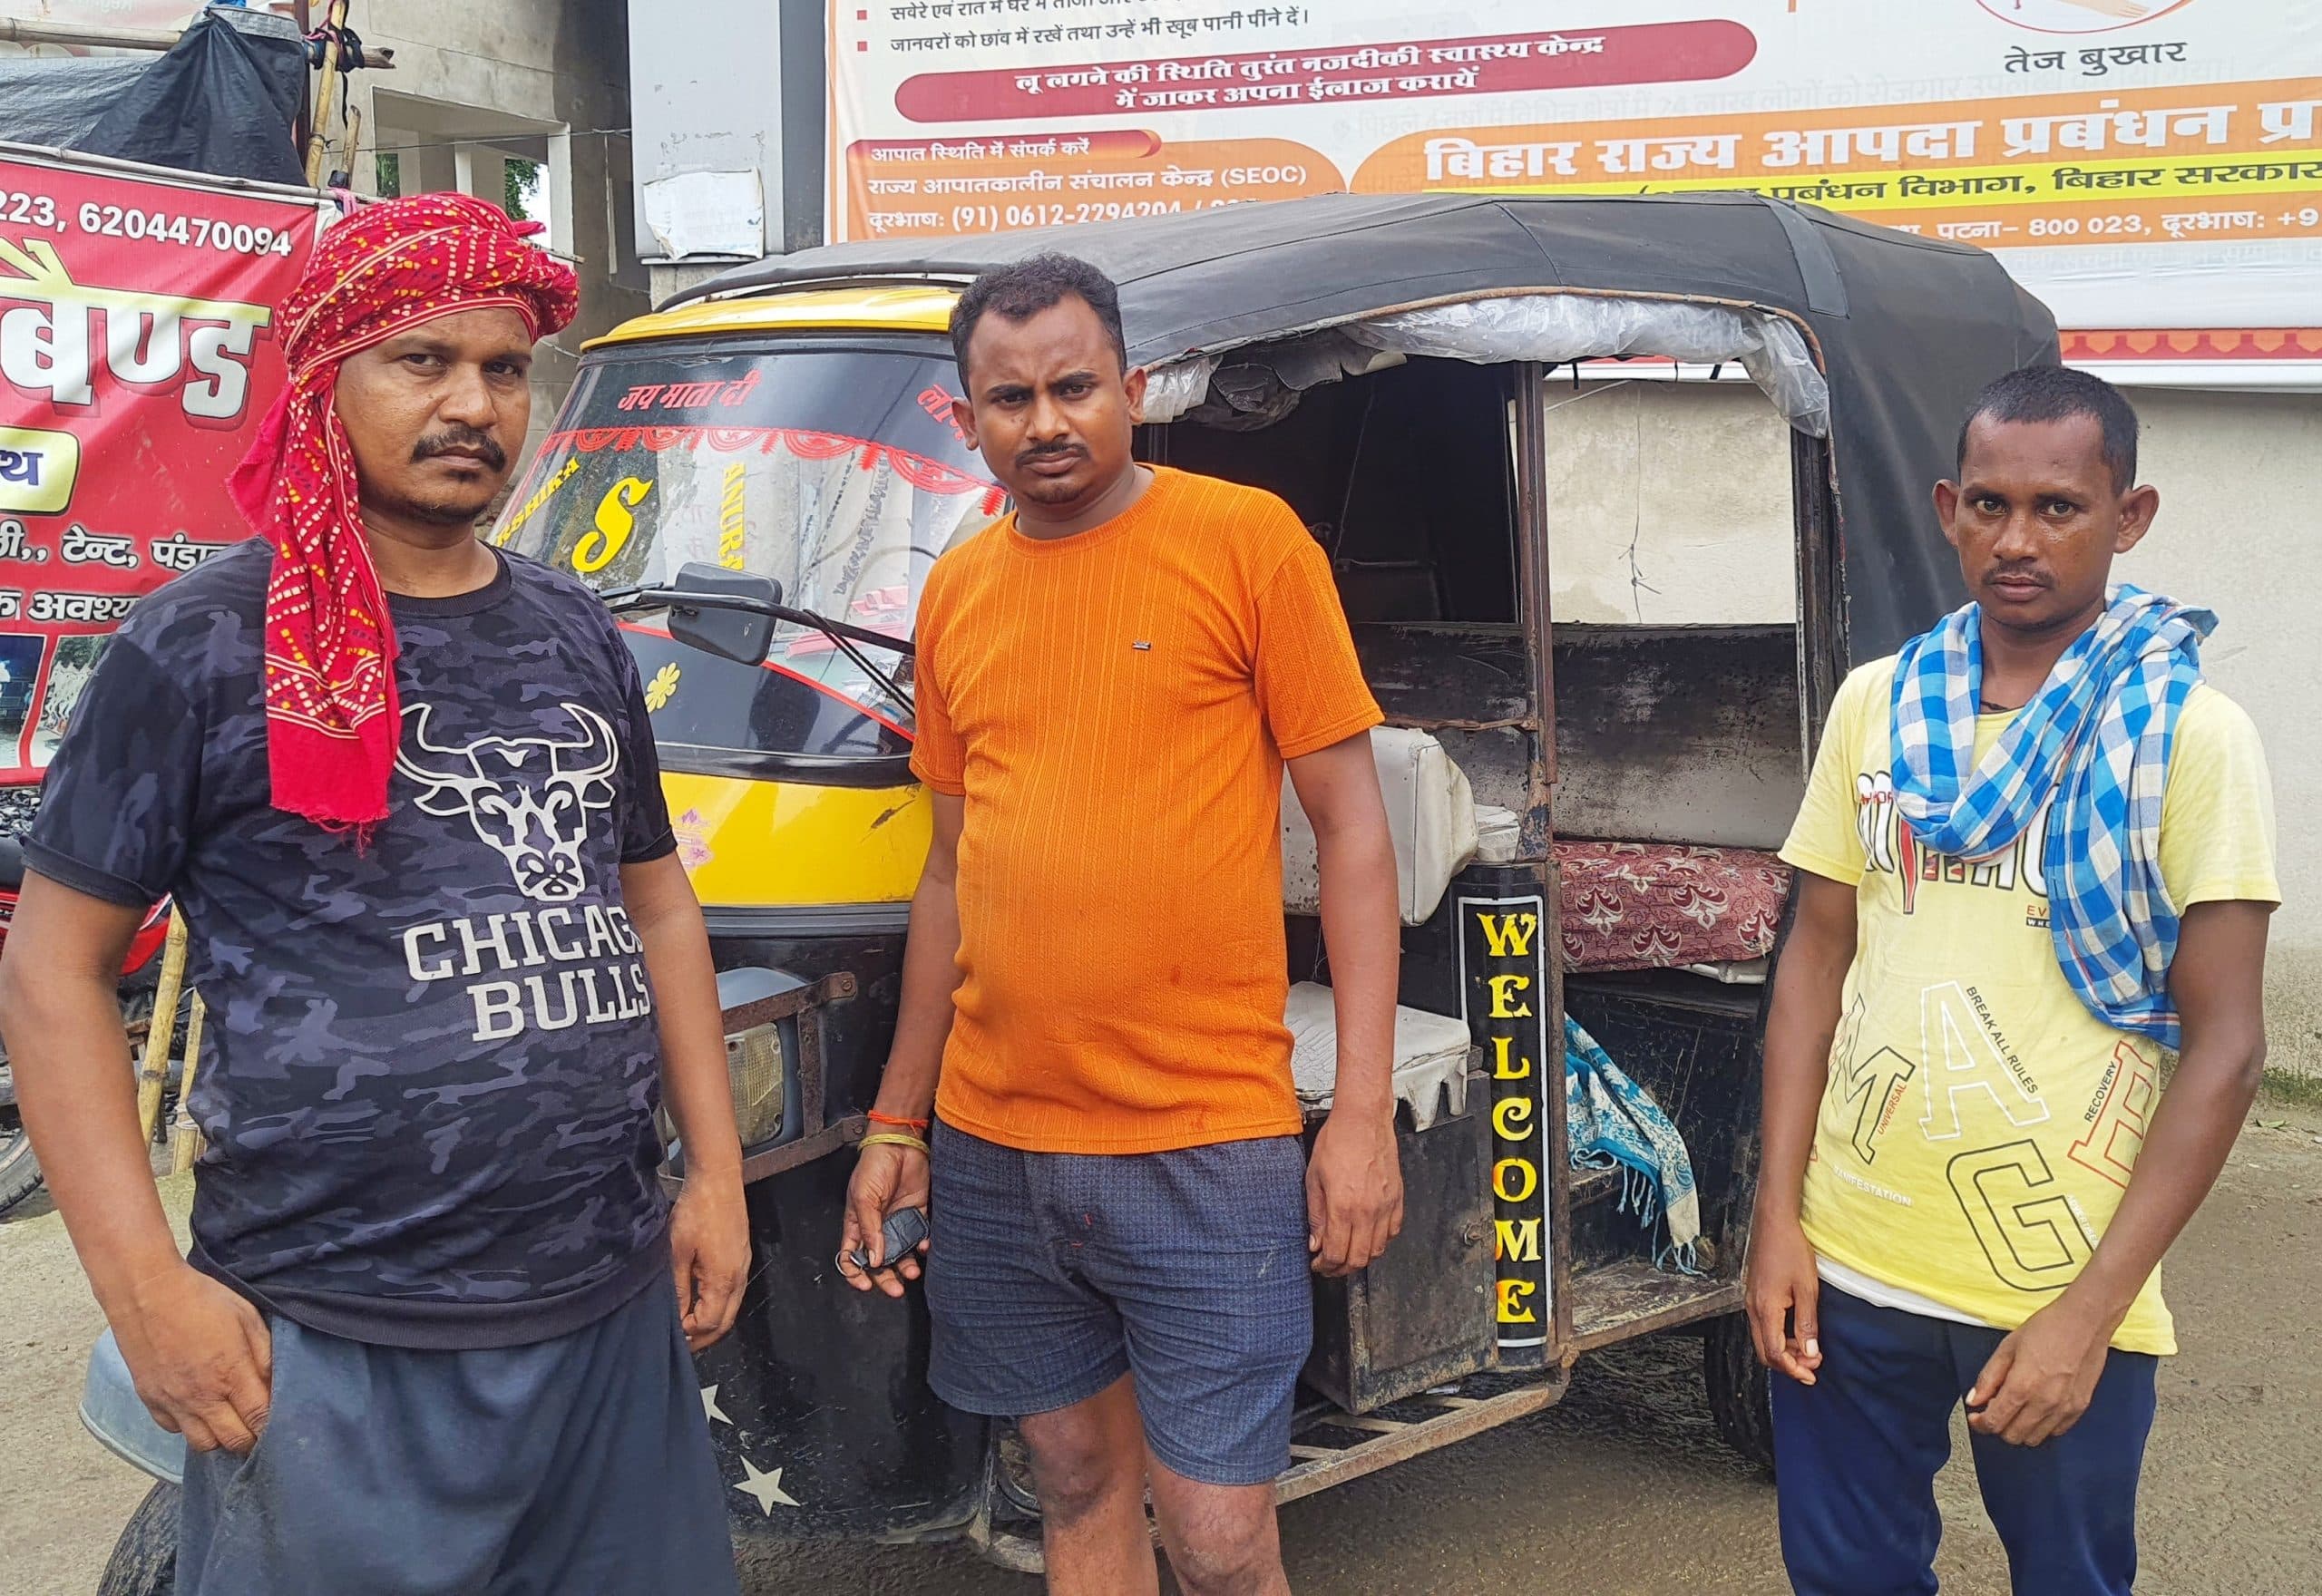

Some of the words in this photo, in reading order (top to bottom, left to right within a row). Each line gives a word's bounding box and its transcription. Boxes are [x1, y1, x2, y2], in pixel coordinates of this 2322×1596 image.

[890, 1, 928, 20] सवेरे
[932, 0, 954, 18] एवं
[957, 2, 987, 15] रात
[891, 33, 951, 52] जानवरों
[954, 30, 977, 48] को
[981, 29, 1010, 46] छांव
[1015, 26, 1032, 44] में
[1033, 24, 1064, 43] रखें
[1067, 25, 1101, 41] तथा
[1105, 18, 1137, 38] उन्हें
[1140, 16, 1162, 35] भी
[1166, 18, 1198, 39] खूब
[1203, 11, 1243, 32] पानी
[1246, 7, 1282, 28] पीने
[1014, 73, 1043, 94] लू
[1045, 66, 1109, 89] लगने
[1114, 63, 1151, 84] की
[1156, 59, 1236, 83] स्थिति
[1239, 53, 1298, 82] तुरंत
[1301, 45, 1423, 73] नजदीकी
[1427, 41, 1532, 66] स्वास्थ्य
[1536, 34, 1607, 57] केन्द्र
[2004, 45, 2066, 73] तेज
[2078, 42, 2189, 76] बुखार
[1115, 87, 1139, 109] में
[1141, 89, 1220, 108] जाकर
[1224, 83, 1302, 103] अपना
[1305, 75, 1395, 101] ईलाज
[1397, 65, 1480, 92] करायें
[871, 146, 926, 162] आपात
[931, 141, 986, 161] स्थिति
[990, 140, 1005, 159] में
[1009, 138, 1057, 158] संपर्क
[1059, 136, 1090, 156] करें
[1423, 138, 1582, 181] बिहार
[1595, 133, 1742, 174] राज्य
[1761, 120, 1984, 169] आपदा
[2000, 99, 2238, 160] प्रबंधन
[2256, 99, 2322, 144] प्र
[867, 179, 917, 194] राज्य
[922, 170, 1063, 194] आपातकालीन
[1068, 169, 1156, 190] संचालन
[1160, 164, 1215, 188] केन्द्र
[1220, 165, 1307, 189] (SEOC)
[1898, 175, 2037, 197] विभाग,
[2052, 167, 2167, 190] बिहार
[2173, 161, 2322, 185] सरकार
[78, 201, 292, 258] 6204470094
[951, 205, 999, 232] (91)
[2028, 218, 2080, 237] 800
[2087, 214, 2151, 236] 023,
[618, 384, 667, 412] जय
[659, 381, 727, 409] माता
[719, 368, 763, 407] दी
[0, 450, 44, 486] थ
[571, 475, 655, 574] S
[403, 904, 644, 982] CHICAG
[466, 962, 652, 1042] BULLS
[1966, 986, 1997, 1030] BREAK
[1990, 1032, 2011, 1055] ALL
[2006, 1054, 2039, 1095] RULES
[1877, 1084, 1907, 1135] UNIVERSAL
[2084, 1060, 2117, 1123] RECOVERY
[1476, 912, 1542, 1324] WELCOME
